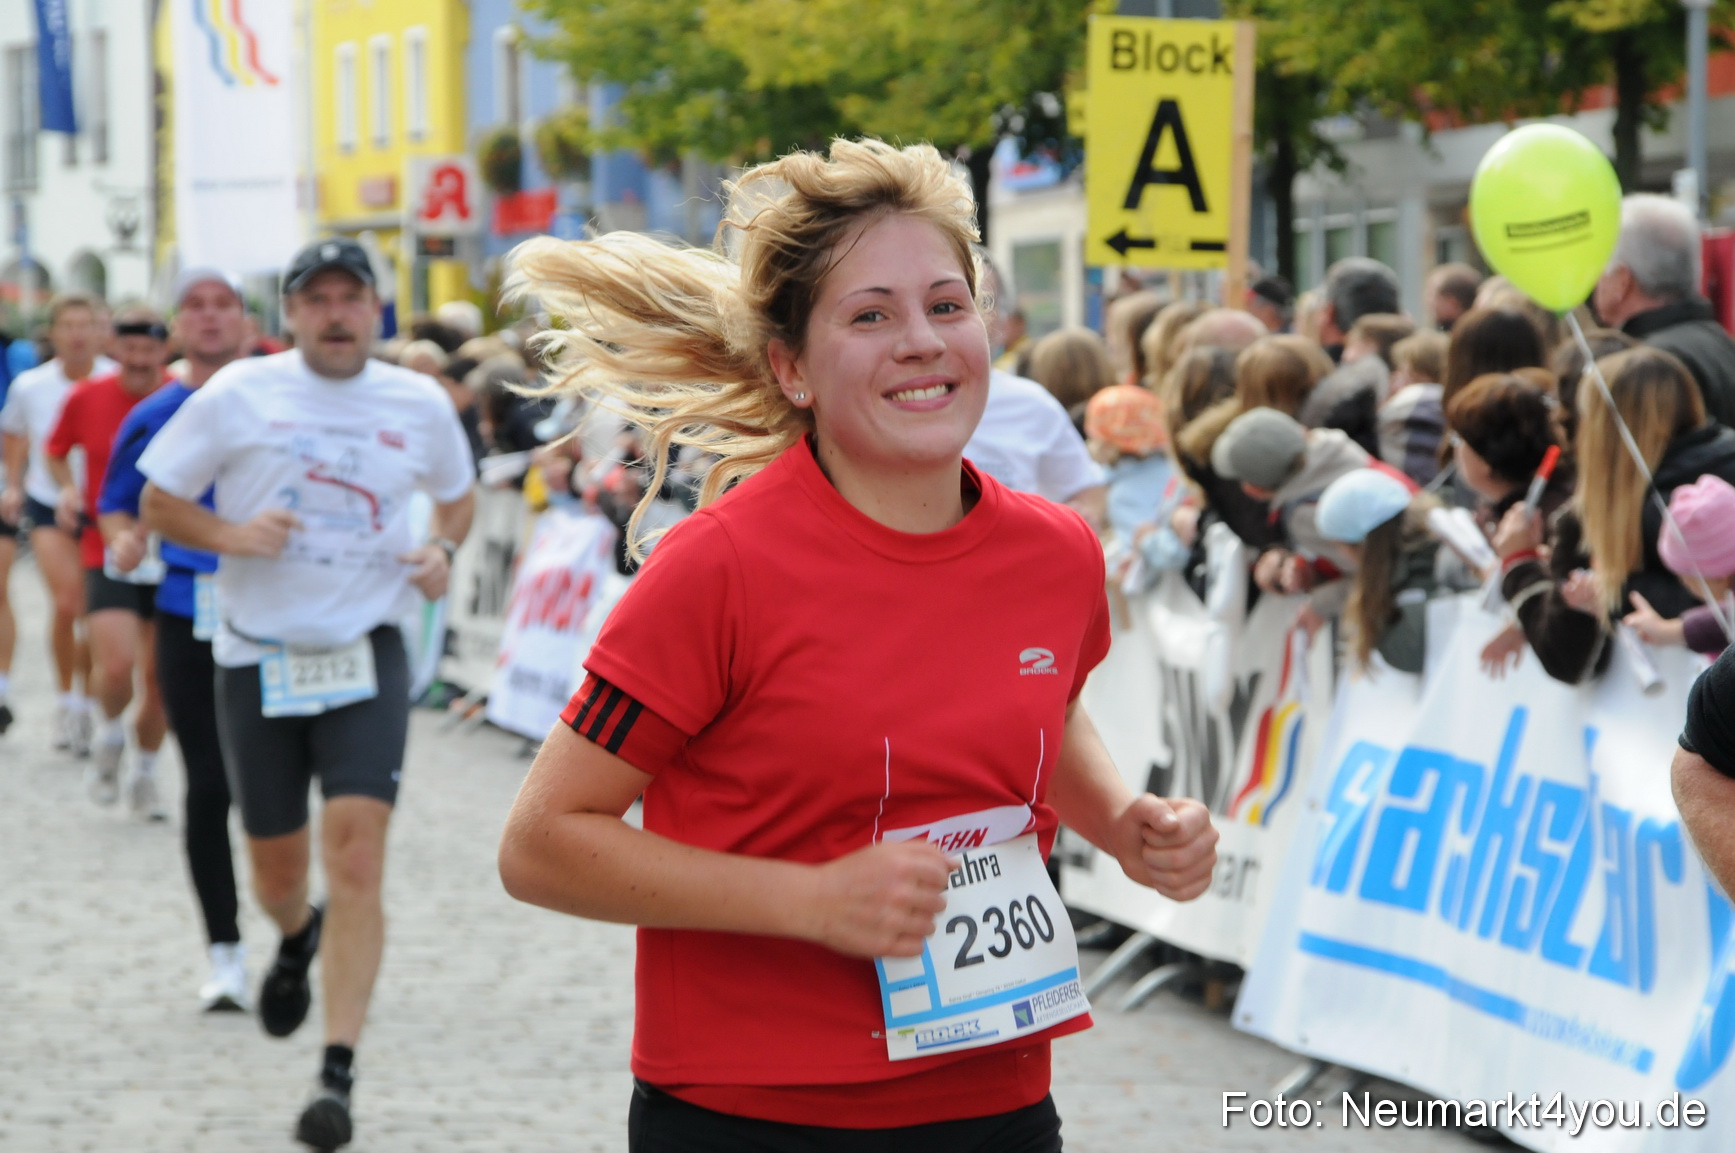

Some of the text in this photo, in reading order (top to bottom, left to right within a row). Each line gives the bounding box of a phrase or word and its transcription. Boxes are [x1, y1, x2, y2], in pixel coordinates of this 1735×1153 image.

[1111, 29, 1233, 74] Block
[1122, 97, 1209, 213] A
[292, 655, 358, 687] 2212
[945, 894, 1055, 971] 2360
[1032, 981, 1083, 1014] PFLEIDERER
